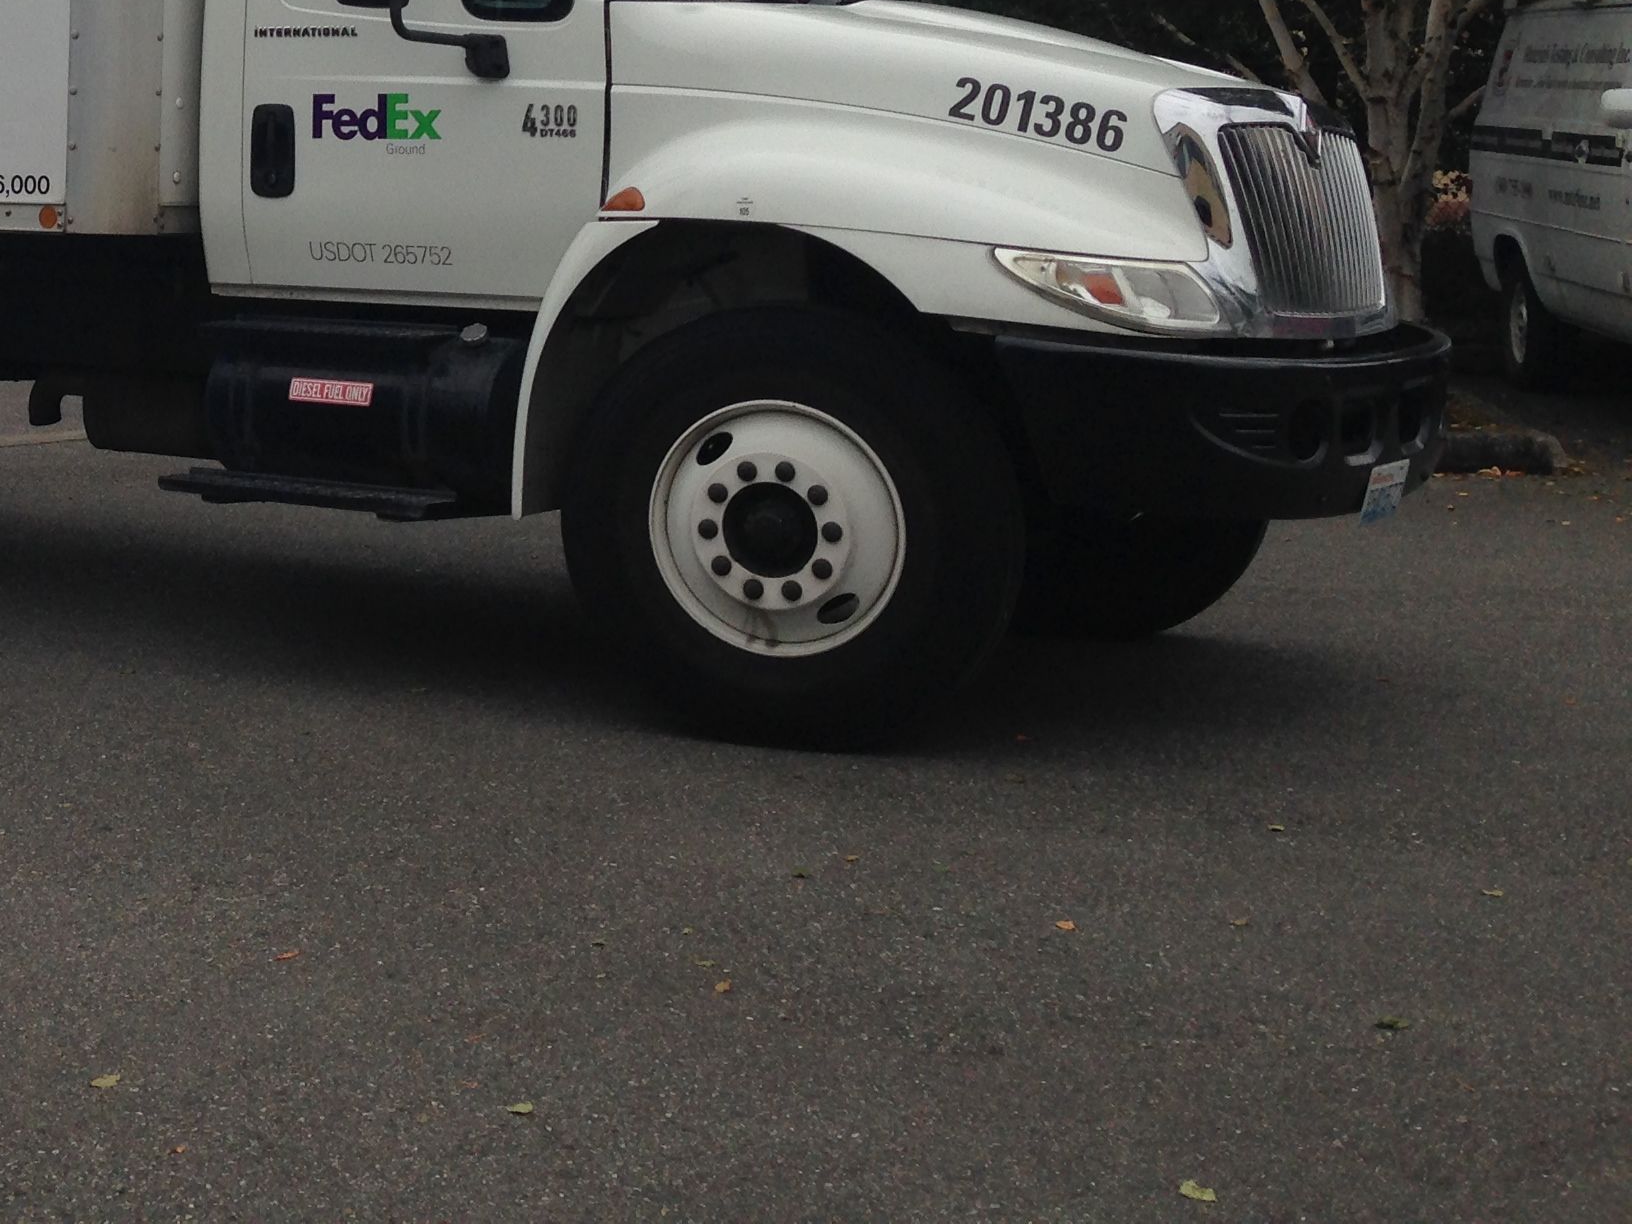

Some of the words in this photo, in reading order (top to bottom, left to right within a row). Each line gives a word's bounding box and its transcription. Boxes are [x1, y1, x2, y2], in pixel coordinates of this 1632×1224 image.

[254, 26, 358, 38] INTERNATIONAL
[312, 93, 442, 141] FedEx
[522, 103, 578, 137] 4300
[948, 77, 1128, 152] 201386
[385, 142, 426, 155] Ground
[309, 240, 377, 263] USDOT
[381, 243, 454, 266] 265752
[292, 381, 322, 398] DIESEL
[323, 384, 344, 400] FUEL
[345, 386, 369, 402] ONLY
